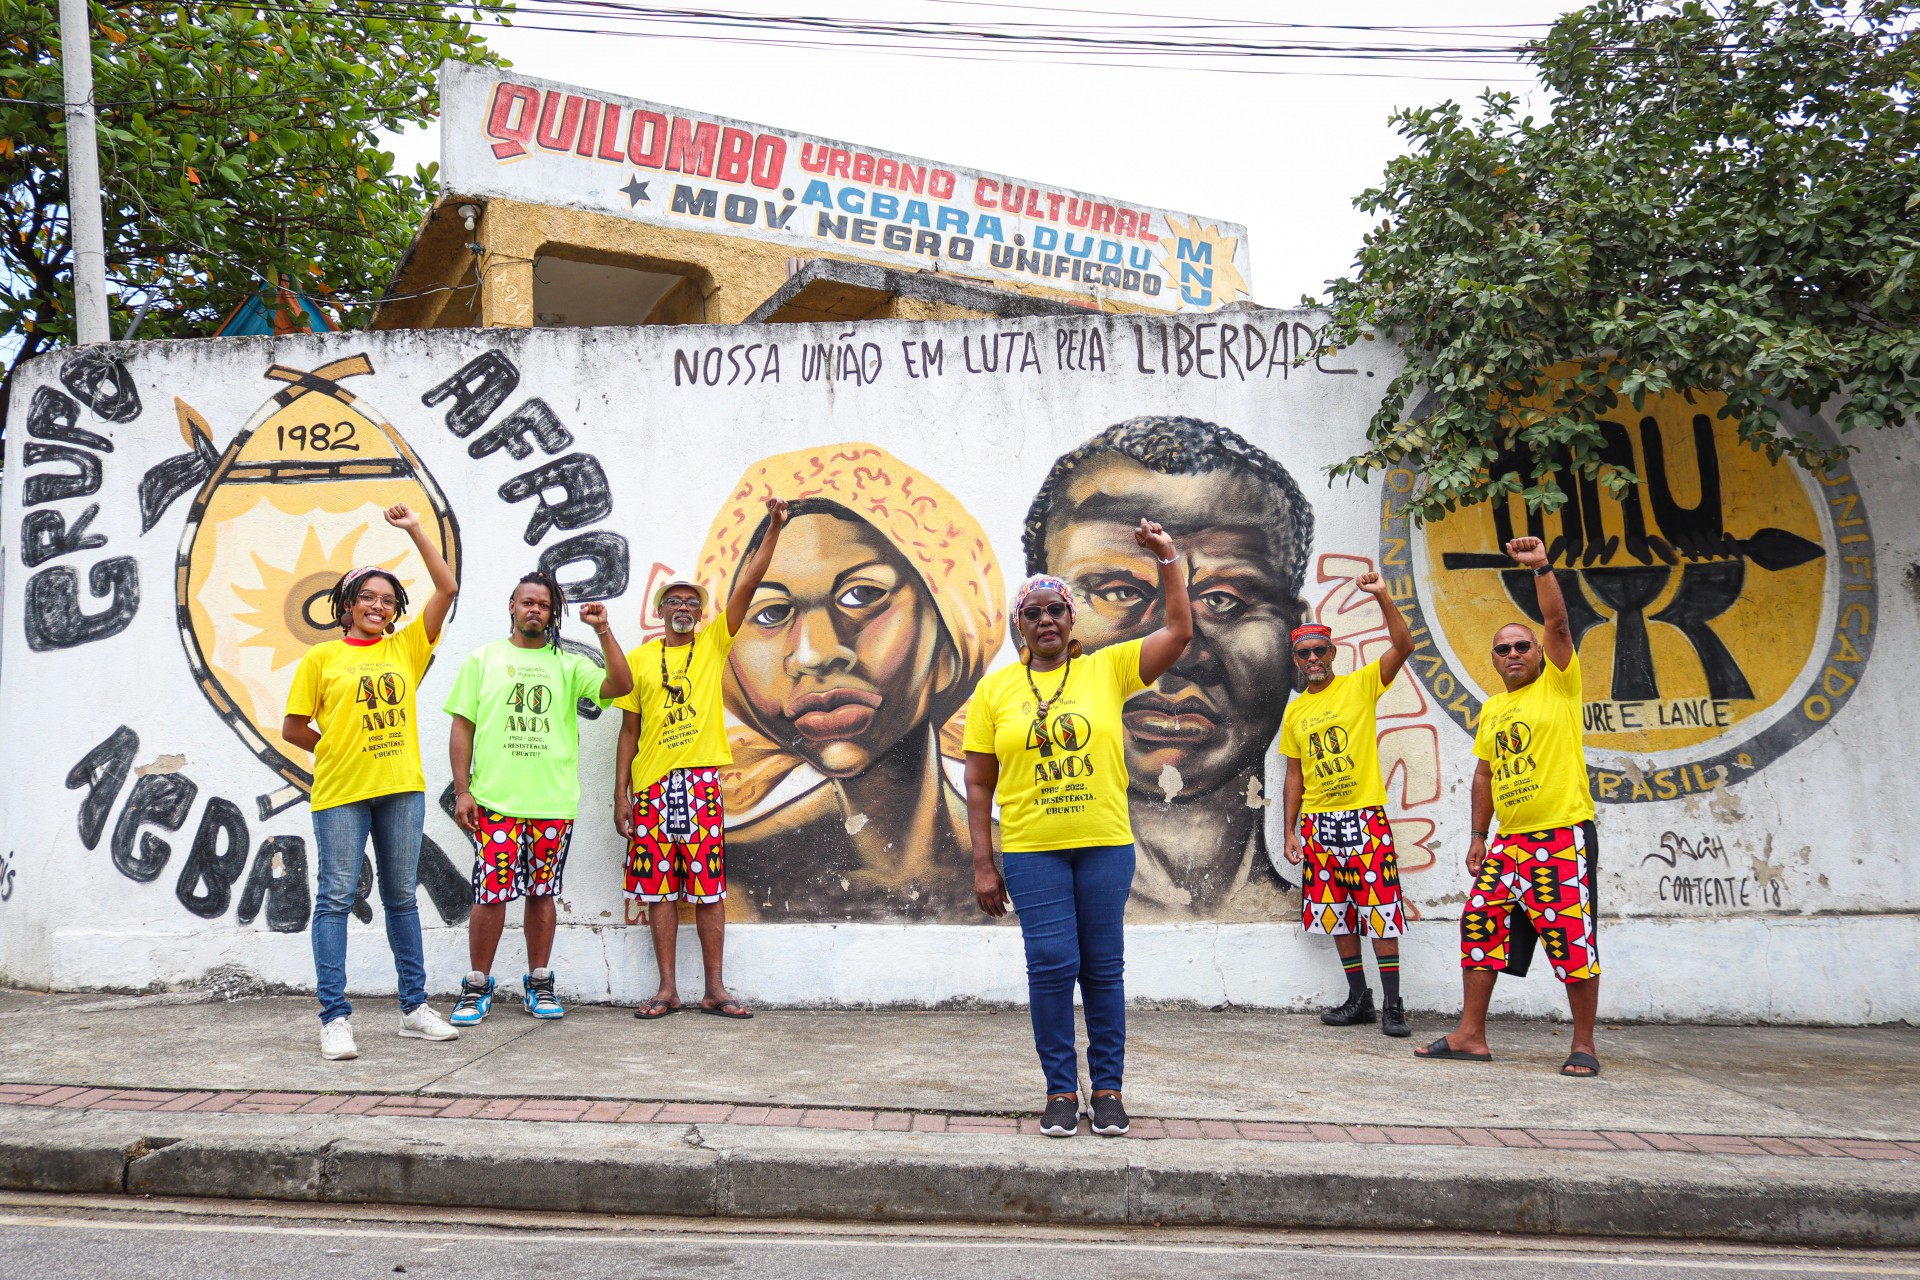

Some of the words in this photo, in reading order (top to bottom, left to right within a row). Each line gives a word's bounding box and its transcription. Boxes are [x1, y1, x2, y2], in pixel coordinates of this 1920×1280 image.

[482, 81, 787, 191] QUILOMBO
[799, 141, 956, 201] URBANO
[974, 177, 1160, 244] CULTURAL
[671, 184, 797, 231] MOV.
[816, 212, 974, 263] NEGRO
[990, 243, 1162, 298] UNIFICADO
[801, 179, 1014, 243] AGBARA
[1033, 225, 1152, 272] DUDU
[1177, 237, 1213, 308] MNU
[673, 343, 781, 387] NOSSA
[802, 332, 881, 388] UNIÃO
[902, 337, 947, 380] EM
[965, 332, 1041, 376] LUTA
[1057, 327, 1106, 373] PELA
[278, 420, 360, 452] 1982
[22, 345, 143, 652] GRUPO
[422, 349, 630, 602] AFRO
[356, 672, 405, 710] 40
[506, 683, 552, 714] 40
[362, 708, 405, 733] ANOS
[504, 716, 550, 733] ANOS
[1583, 703, 1616, 732] URE
[1658, 699, 1730, 727] LANCE
[1026, 713, 1091, 758] 40
[1309, 725, 1348, 760] 40
[1034, 754, 1094, 786] ANOS
[1314, 754, 1355, 780] ANOS
[1597, 764, 1720, 801] RASIL
[1041, 785, 1059, 795] 1982
